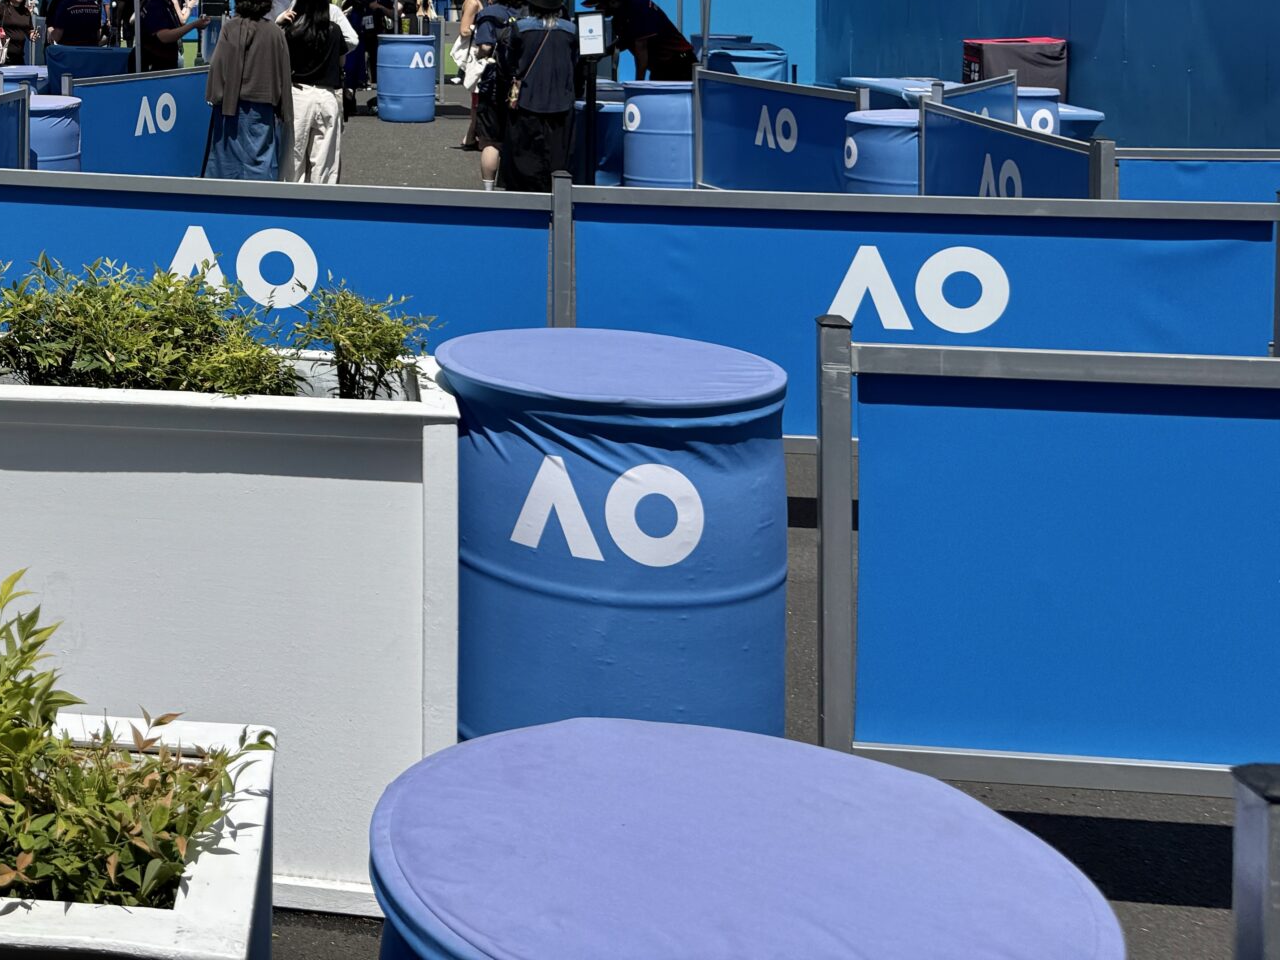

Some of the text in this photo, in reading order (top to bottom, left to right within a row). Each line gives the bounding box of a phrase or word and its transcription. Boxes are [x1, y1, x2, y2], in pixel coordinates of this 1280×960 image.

[409, 51, 435, 69] AO
[135, 92, 177, 137] AO
[754, 105, 798, 153] AO
[979, 153, 1022, 198] AO
[167, 225, 318, 309] AO
[826, 245, 1010, 334] AO
[510, 455, 705, 567] AO
